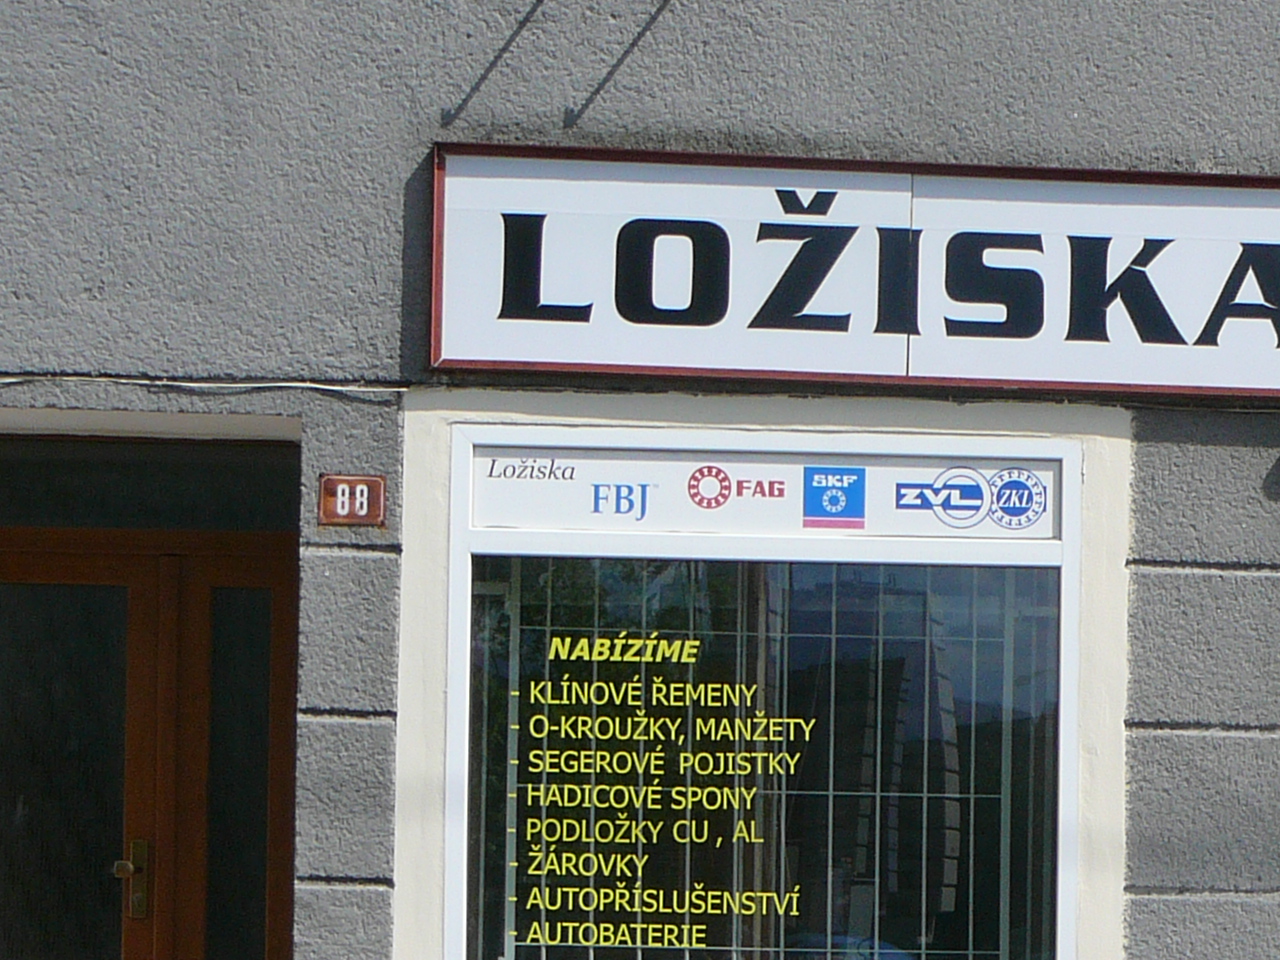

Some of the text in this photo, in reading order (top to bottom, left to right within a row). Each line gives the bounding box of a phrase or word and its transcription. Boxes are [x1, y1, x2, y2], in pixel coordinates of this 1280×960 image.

[487, 458, 576, 481] Ložiska
[811, 474, 859, 488] SKF
[337, 484, 369, 516] 88
[591, 483, 650, 521] FBJ
[736, 480, 786, 498] FAG
[899, 489, 982, 507] ZVL
[998, 489, 1032, 508] ZKL
[548, 631, 700, 662] NABÍZÍME
[531, 674, 757, 706] KLÍNOVÉ ŘEMENY
[530, 709, 816, 748] O-KROUŽKY, MANŽETY
[529, 745, 800, 775] SEGEROVÉ POJISTKY
[528, 779, 757, 810] HADICOVÉ SPONY
[527, 812, 663, 845] PODLOŽKY
[734, 820, 764, 843] AL
[528, 844, 648, 876] ŽÁROVKY
[527, 881, 800, 915] AUTOPŘÍSLUŠENSTVÍ
[526, 922, 706, 947] AUTOBATERIE
